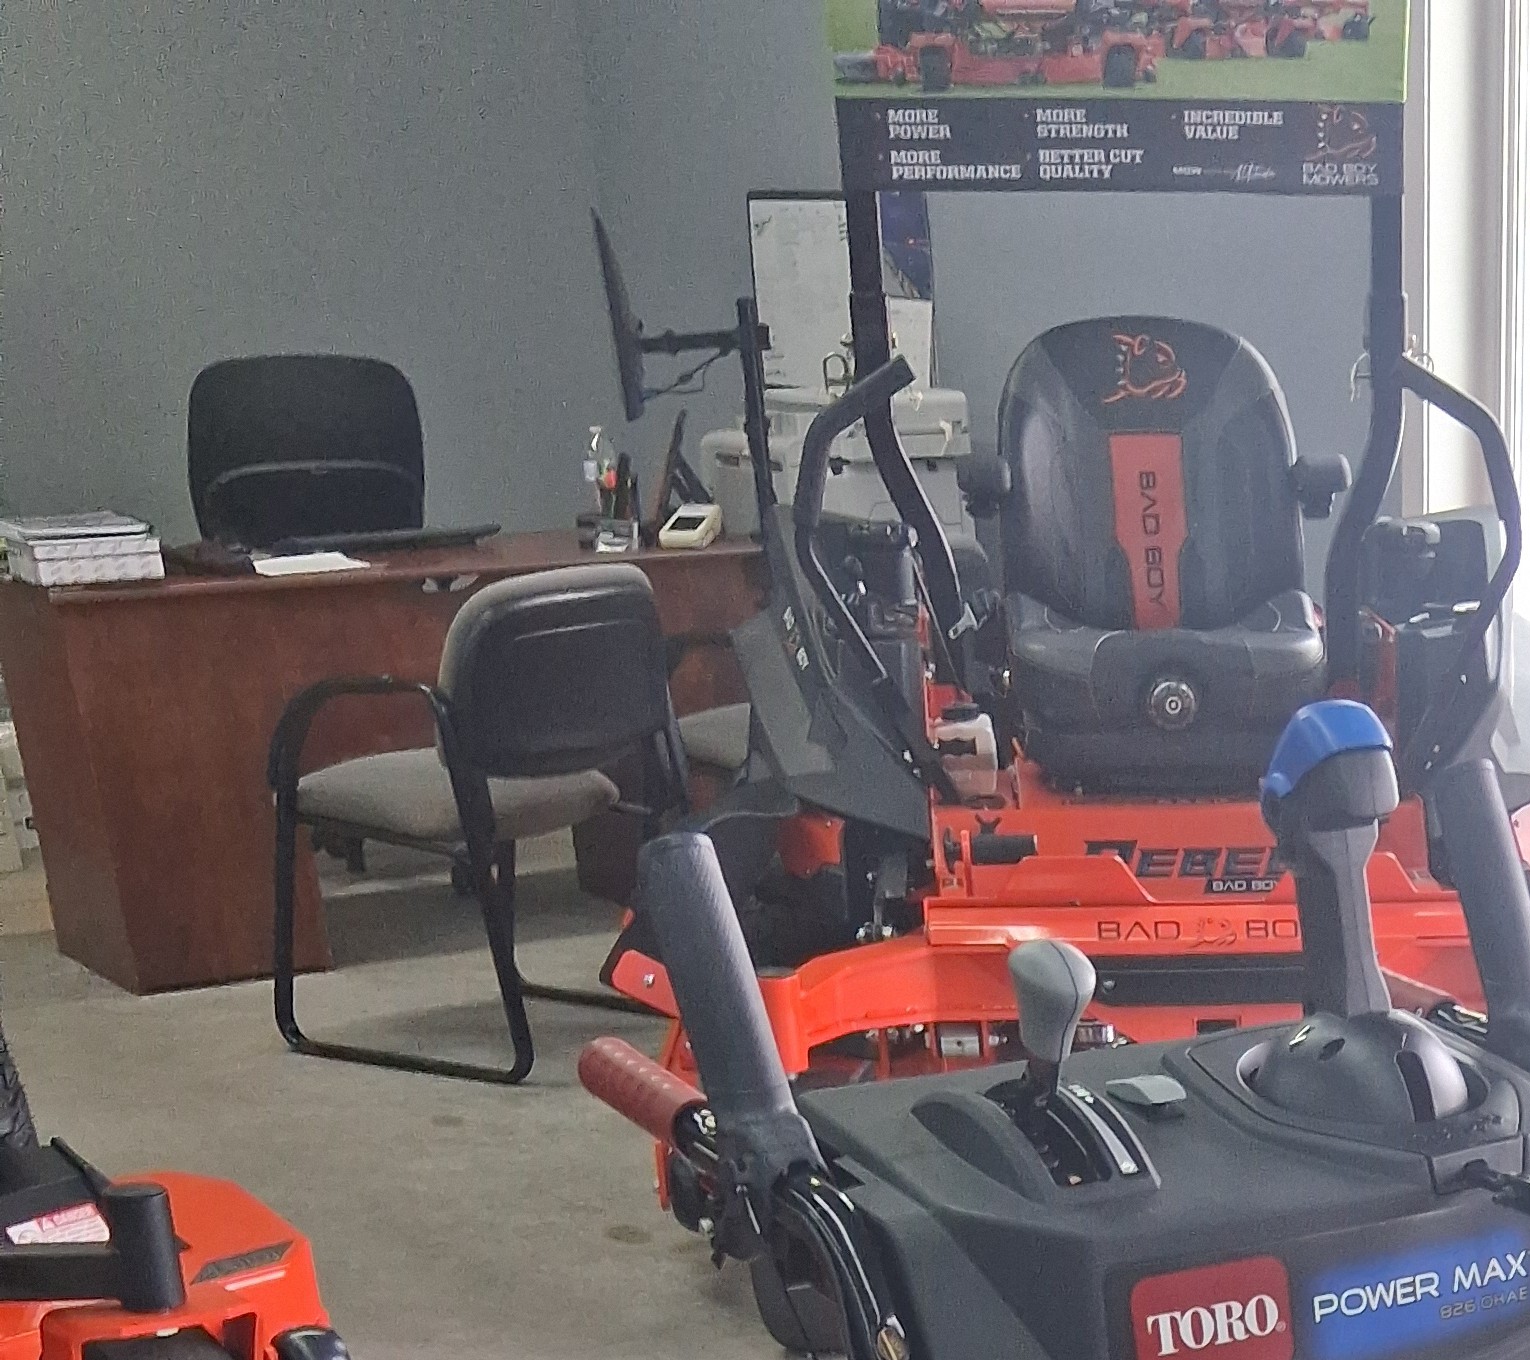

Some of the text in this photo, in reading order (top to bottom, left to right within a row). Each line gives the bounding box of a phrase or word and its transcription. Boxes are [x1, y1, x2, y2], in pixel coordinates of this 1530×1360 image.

[887, 108, 940, 124] MORE
[1035, 108, 1087, 124] MORE
[1183, 110, 1285, 126] INCREDIBLE
[887, 124, 952, 140] POWER
[1036, 123, 1129, 140] STRENGTH
[1184, 125, 1240, 140] VALUE
[889, 149, 942, 165] MORE
[1038, 149, 1145, 165] BETTER CUT
[890, 165, 1023, 181] PERFORMANCE
[1038, 165, 1114, 180] QUALITY
[1302, 163, 1379, 174] BAD BOY
[1302, 173, 1380, 186] MOWERS
[1138, 470, 1166, 607] BAD BOY
[1212, 879, 1280, 892] BAD BO
[1097, 918, 1299, 942] BAD BO
[1312, 1249, 1529, 1324] POWER MAX
[1439, 1301, 1477, 1320] 826
[1147, 1293, 1280, 1358] TORO
